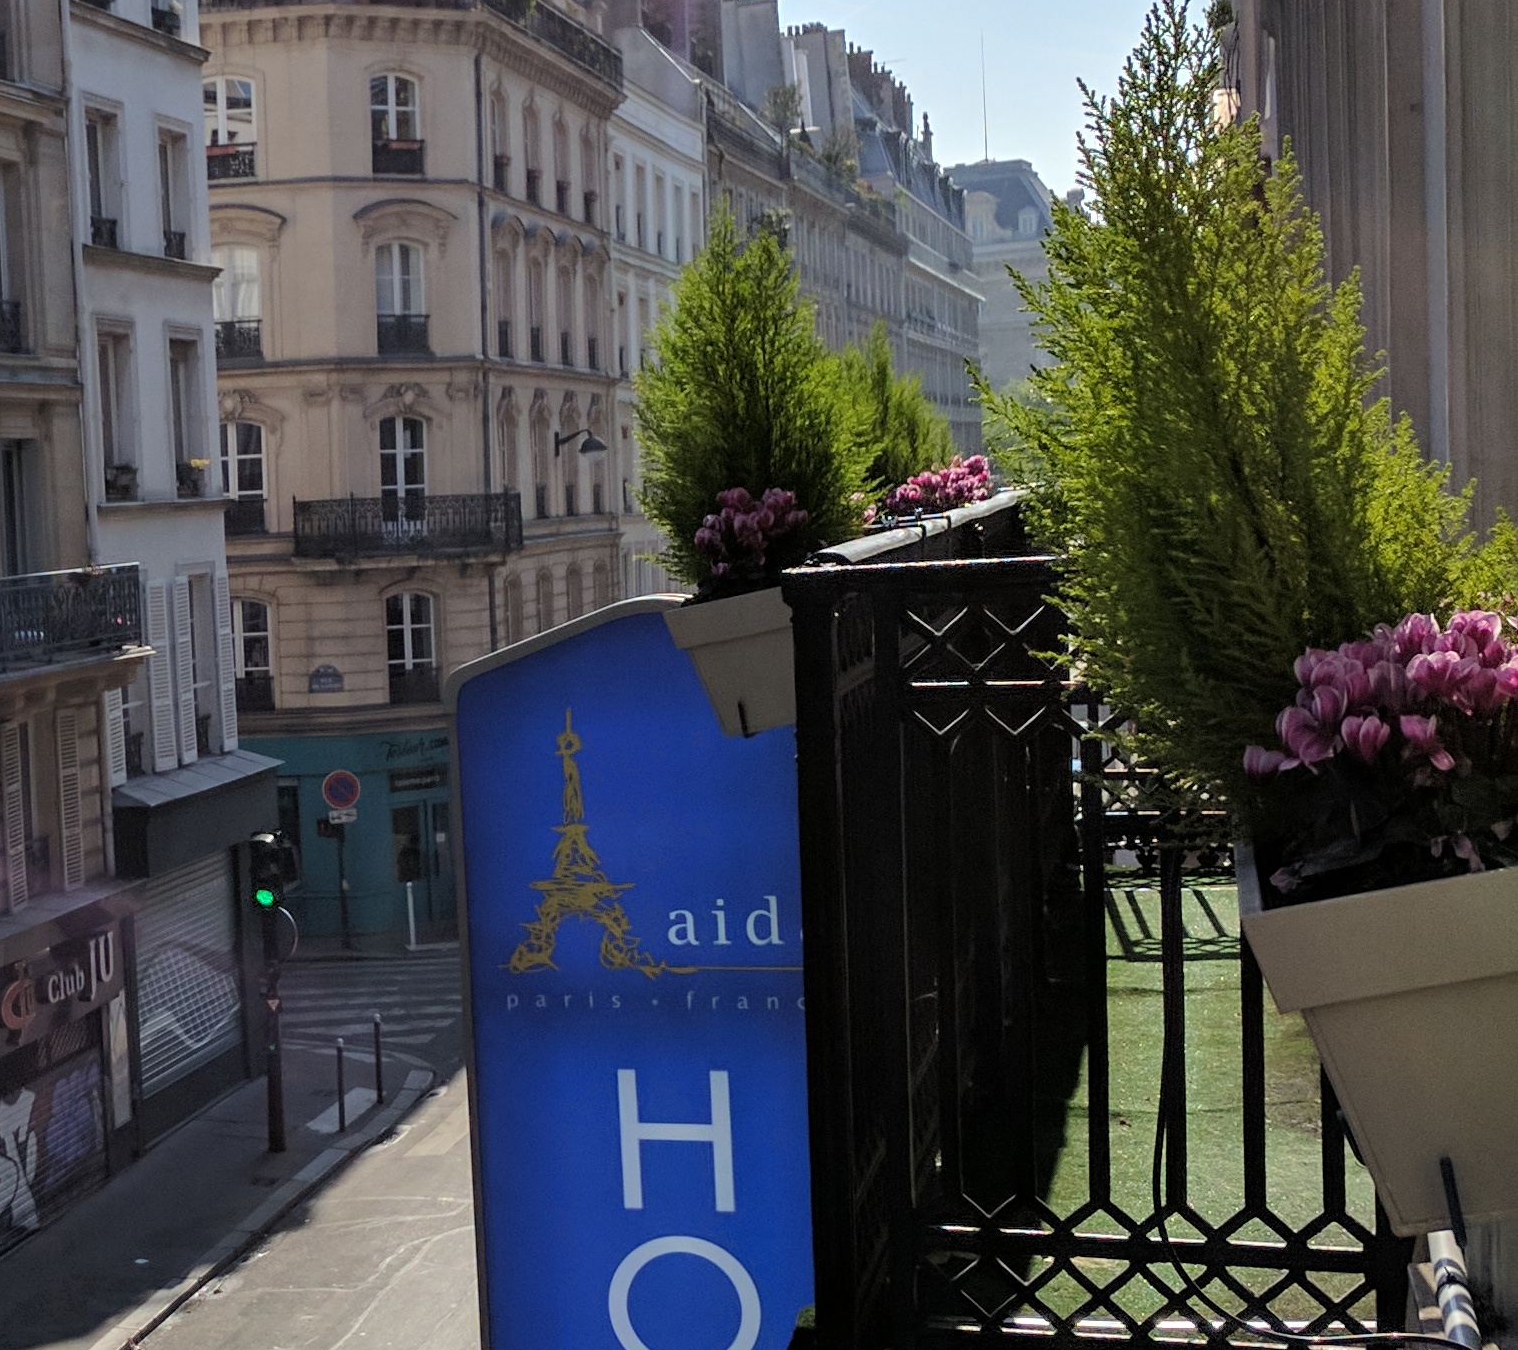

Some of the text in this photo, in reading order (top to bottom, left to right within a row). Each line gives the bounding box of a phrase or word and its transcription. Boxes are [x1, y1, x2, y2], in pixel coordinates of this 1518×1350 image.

[667, 895, 803, 947] aid
[47, 931, 116, 1005] Club JU
[506, 989, 805, 1012] paris franc
